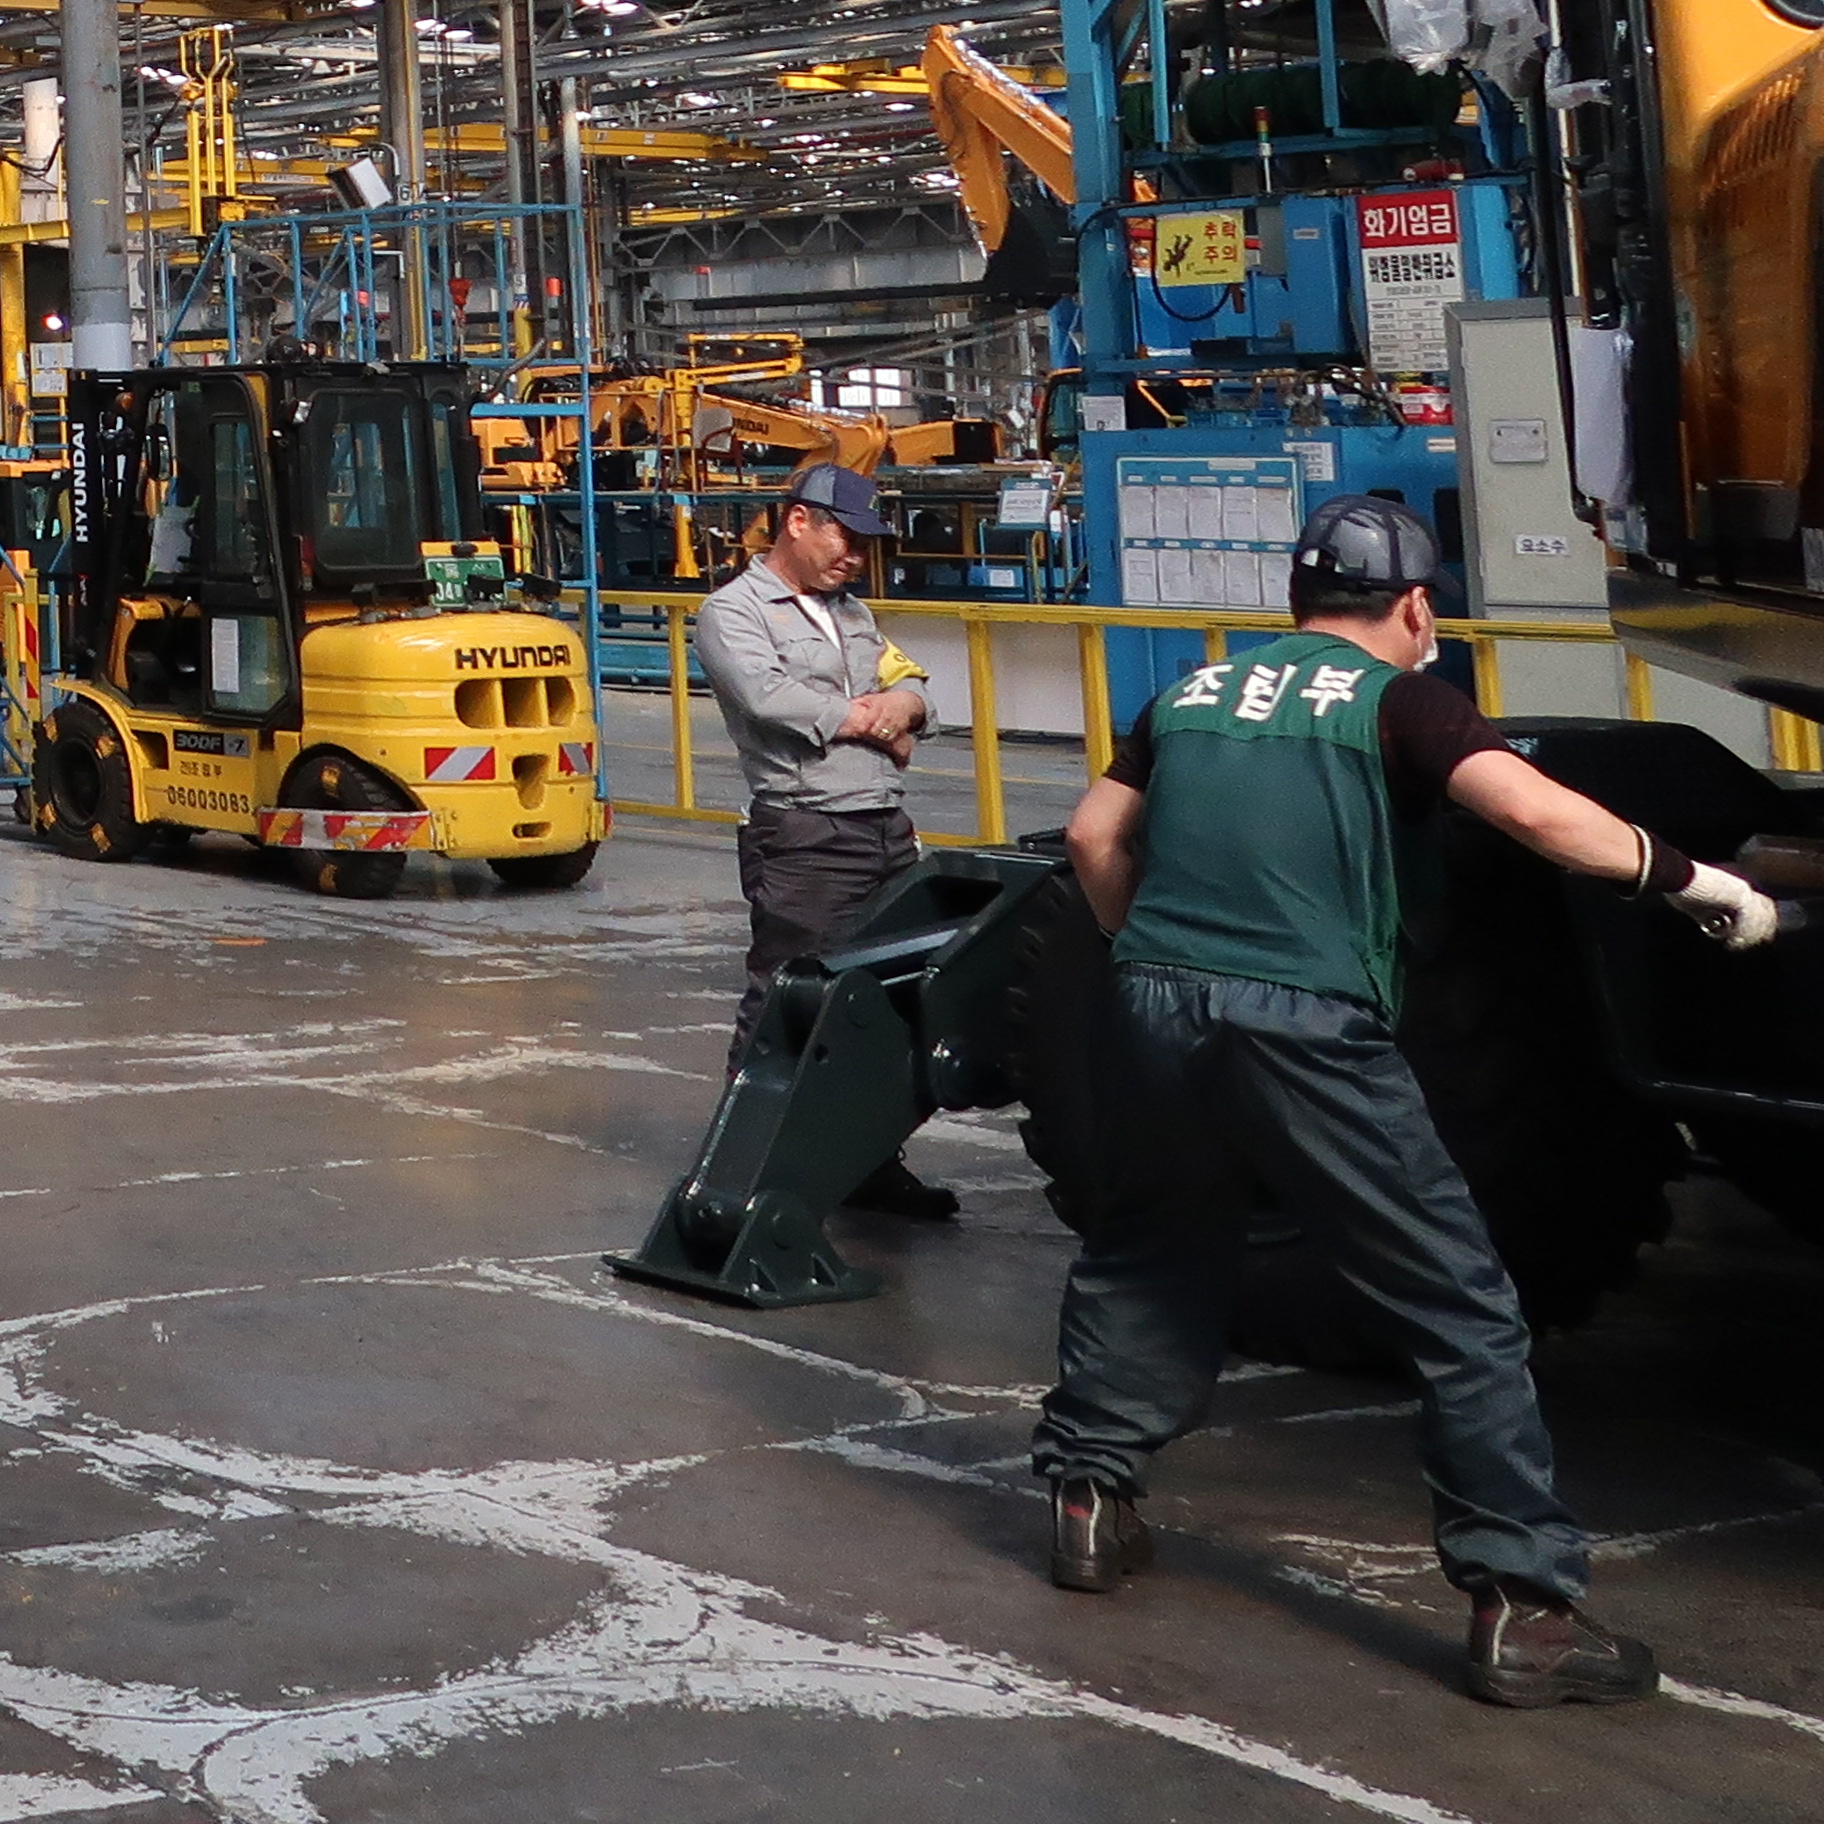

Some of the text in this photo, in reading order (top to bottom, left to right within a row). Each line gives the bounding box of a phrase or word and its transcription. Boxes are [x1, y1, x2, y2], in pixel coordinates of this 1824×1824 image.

[1204, 220, 1238, 239] 추락
[1363, 203, 1452, 238] 화기엄금
[1205, 245, 1238, 264] 주의
[72, 423, 89, 543] HYUNDAI
[1520, 538, 1566, 554] 요소수
[454, 645, 572, 670] HYUNDAI
[1172, 662, 1365, 723] 조립부
